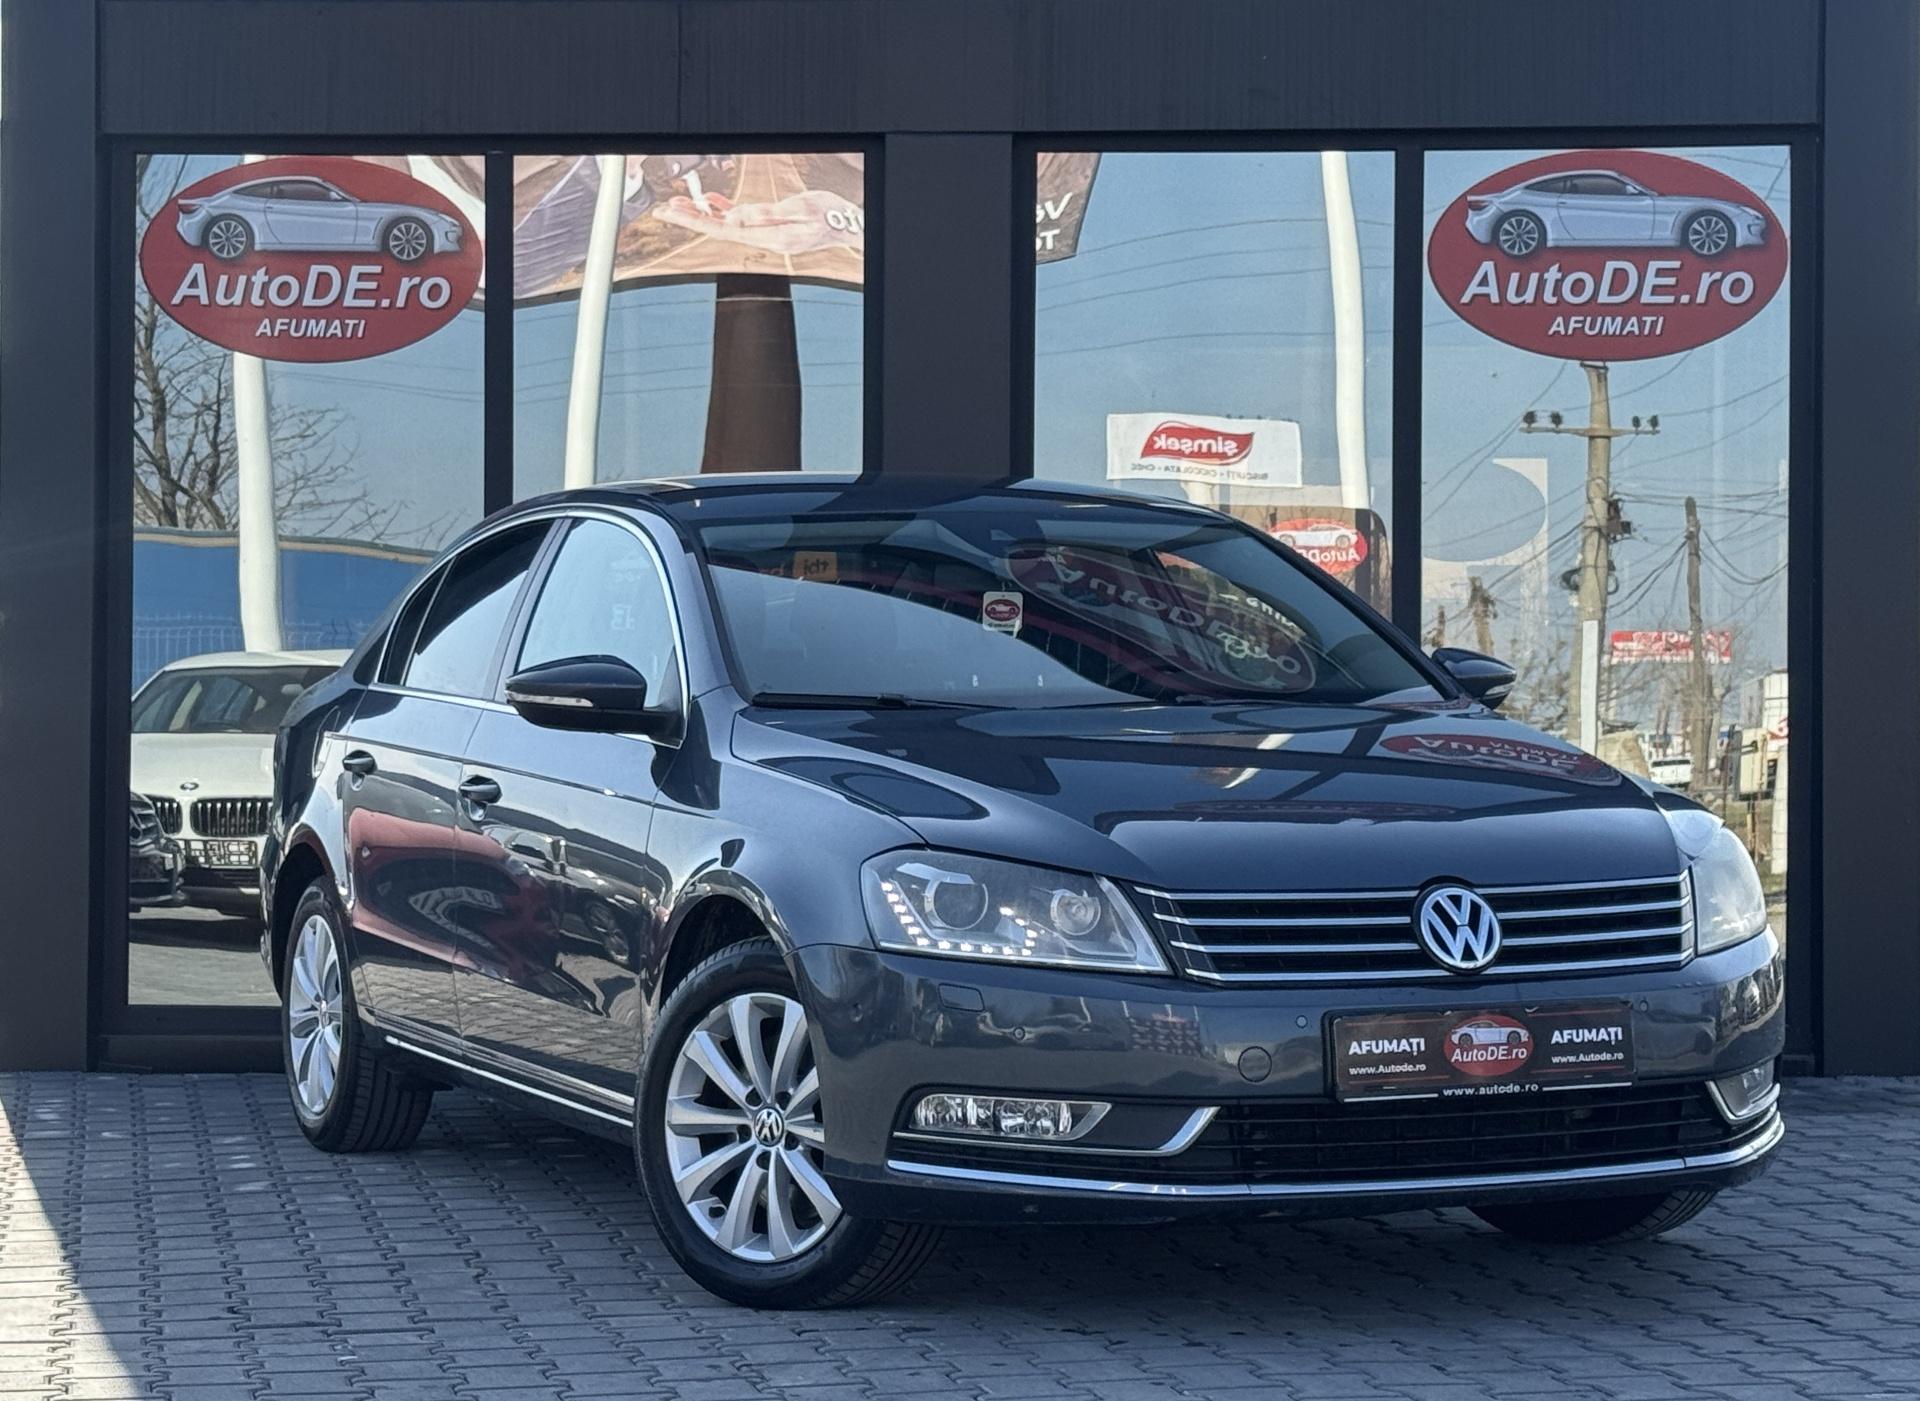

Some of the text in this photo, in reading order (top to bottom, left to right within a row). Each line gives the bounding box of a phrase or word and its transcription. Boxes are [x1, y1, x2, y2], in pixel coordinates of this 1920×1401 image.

[171, 264, 452, 311] AutoDE.ro
[1461, 259, 1755, 306] AutoDE.ro
[255, 318, 366, 340] AFUMATI
[1548, 314, 1664, 337] AFUMATI
[1451, 1045, 1528, 1064] AutoDE.ro
[1551, 1051, 1625, 1064] www.Autode.ro
[1348, 1063, 1427, 1076] www.Autode.ro
[1442, 1082, 1539, 1097] www.autode.ro
